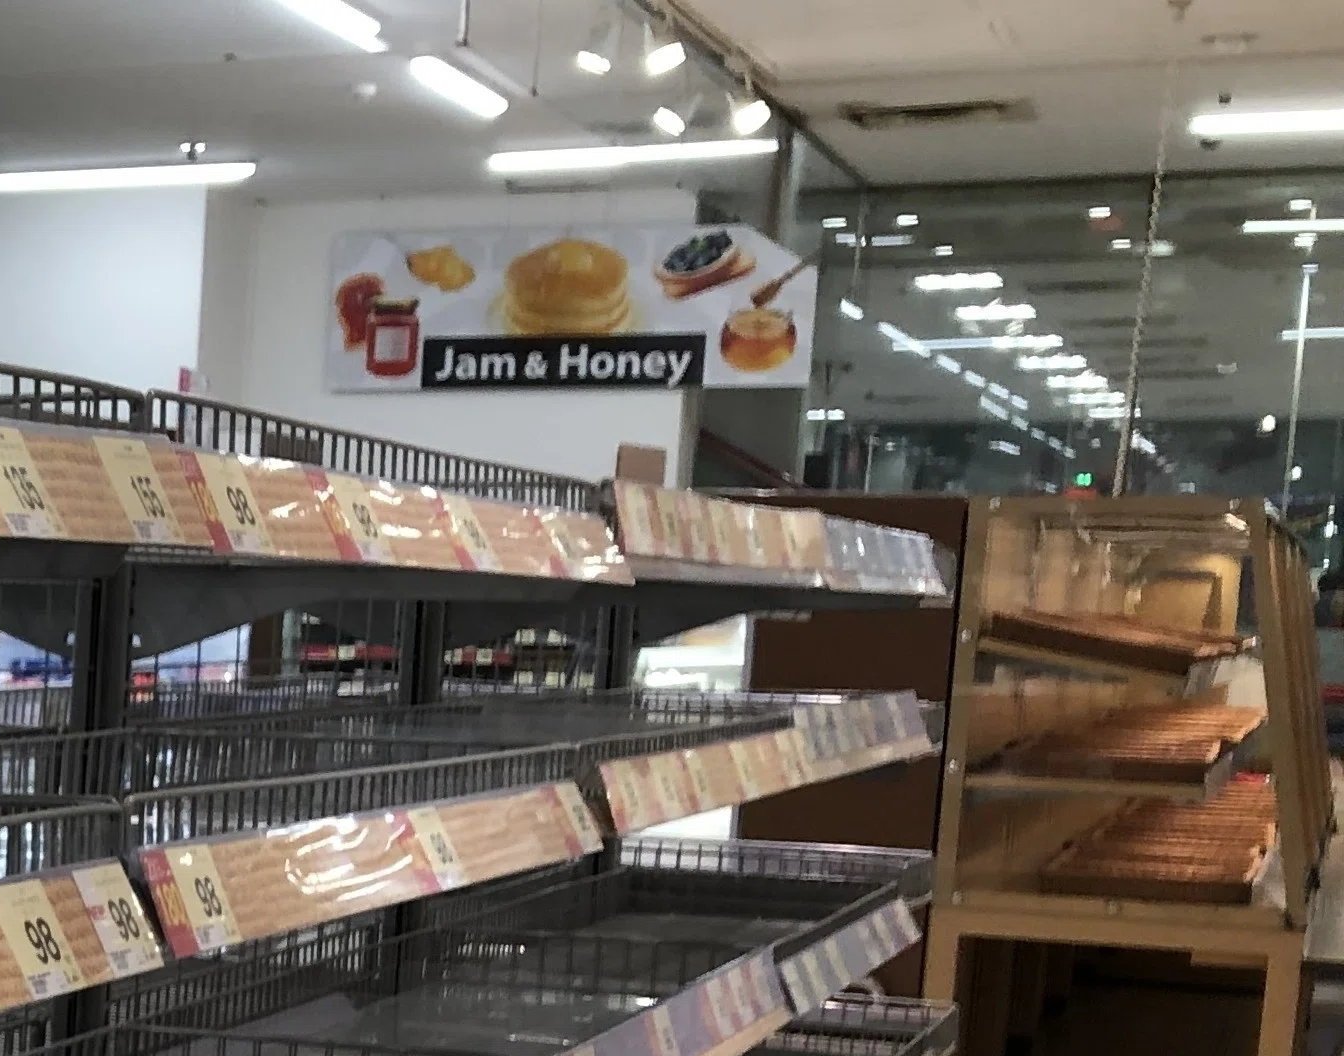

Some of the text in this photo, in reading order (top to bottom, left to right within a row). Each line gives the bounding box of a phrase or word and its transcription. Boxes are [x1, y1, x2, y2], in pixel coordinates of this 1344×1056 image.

[435, 344, 693, 384] Jam & Honey
[225, 485, 256, 526] 98
[194, 876, 223, 918] 98
[24, 916, 63, 965] 98
[107, 897, 142, 943] 98
